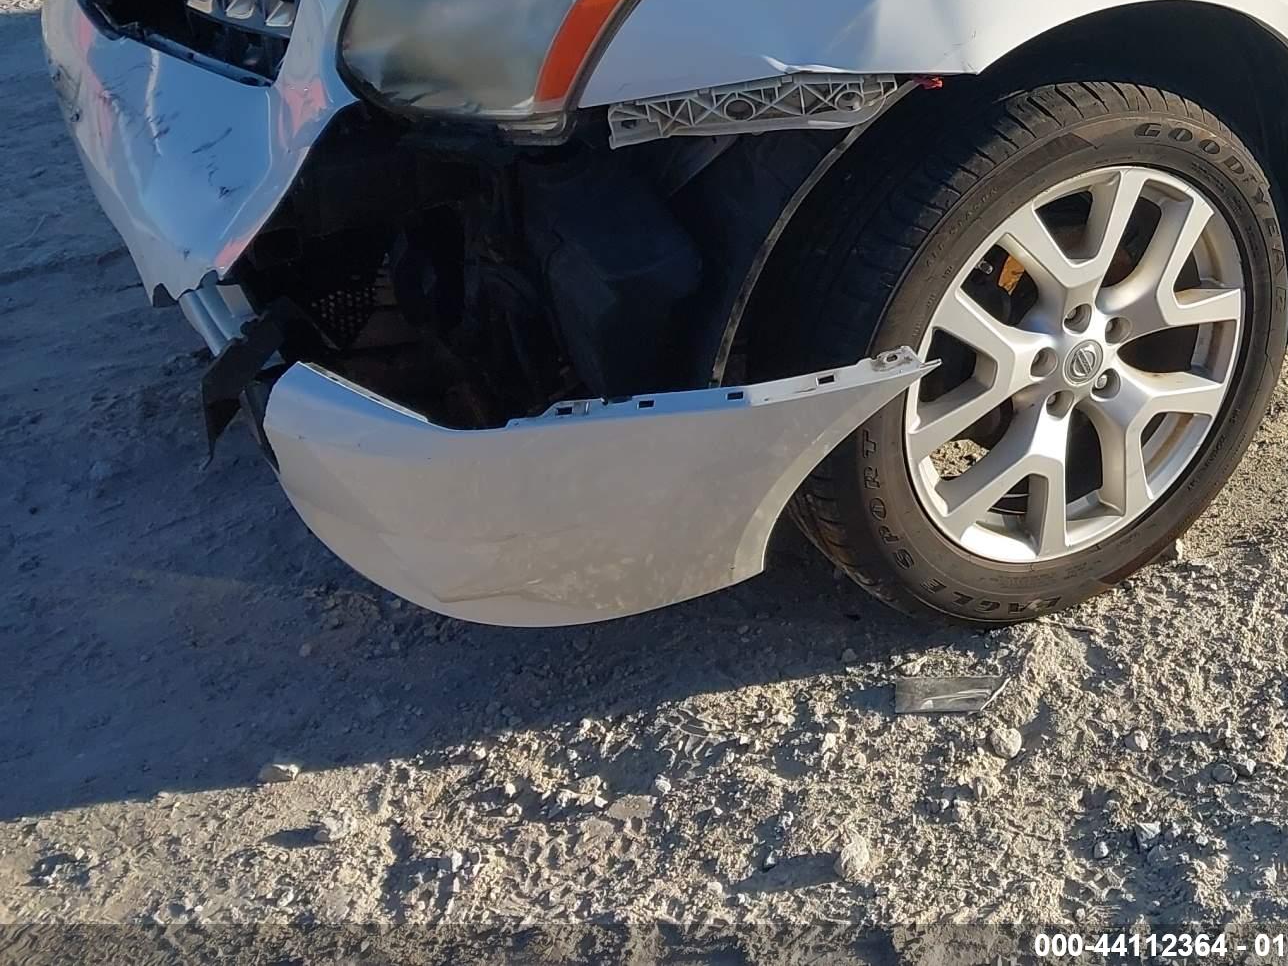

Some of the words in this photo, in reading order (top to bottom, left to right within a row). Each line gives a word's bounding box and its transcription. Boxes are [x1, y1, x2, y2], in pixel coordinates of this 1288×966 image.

[1133, 122, 1288, 314] GOODYEAR
[862, 428, 915, 570] SPORT
[921, 577, 1062, 613] EAGLE
